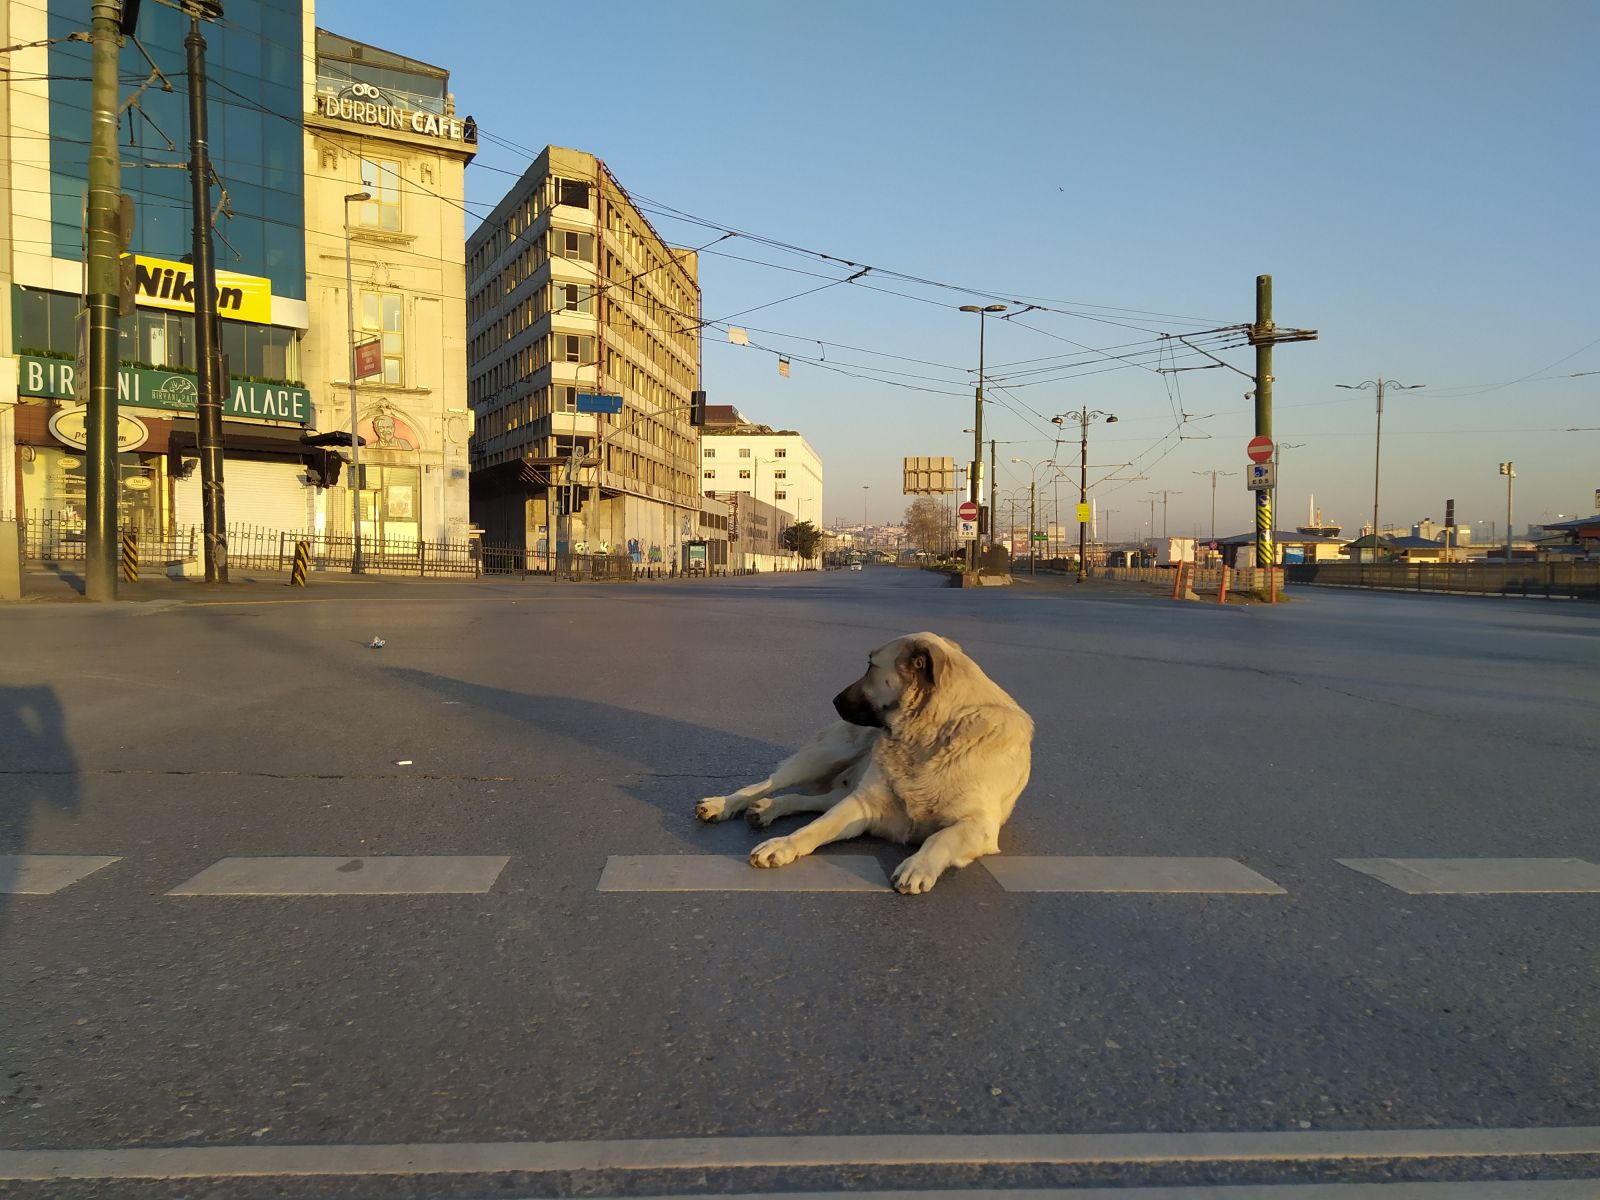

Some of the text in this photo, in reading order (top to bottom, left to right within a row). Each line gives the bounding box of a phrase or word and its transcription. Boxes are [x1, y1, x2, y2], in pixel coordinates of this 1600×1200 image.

[326, 95, 403, 129] DÜRBÜN
[135, 264, 243, 311] Nikn
[28, 361, 139, 402] BIRNI
[222, 385, 304, 419] ALACE
